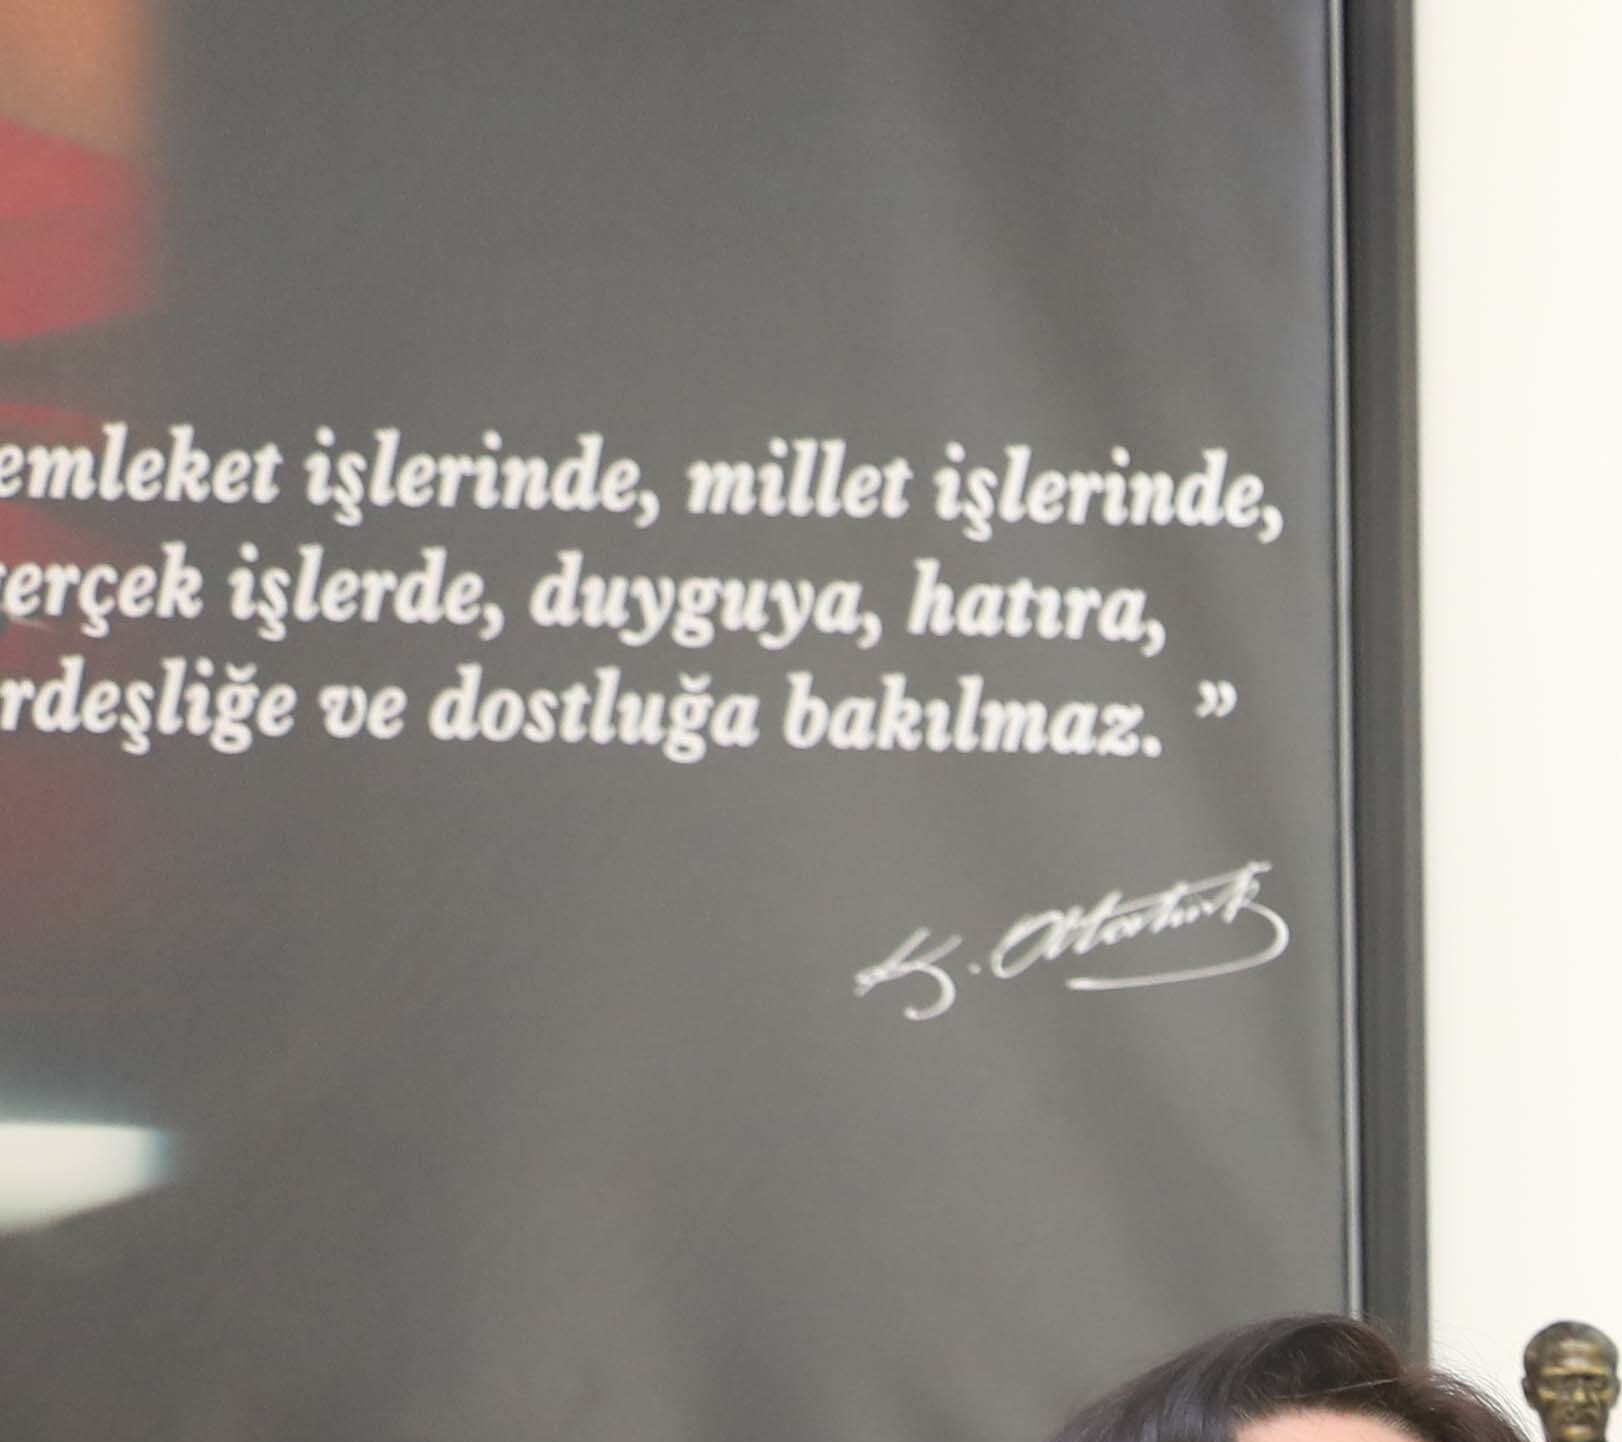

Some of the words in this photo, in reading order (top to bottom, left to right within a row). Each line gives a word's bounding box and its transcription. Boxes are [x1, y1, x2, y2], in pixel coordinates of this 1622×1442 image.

[306, 428, 659, 527] işlerinde,
[689, 439, 912, 517] millet
[935, 443, 1282, 542] işlerinde,
[0, 542, 202, 637] erçek
[230, 544, 503, 640] işlerde,
[531, 551, 881, 649] duyguya,
[909, 559, 1165, 656] hatıra,
[320, 686, 406, 738] ve
[430, 664, 758, 763] dostluğa
[785, 672, 1161, 756] bakılmaz.
